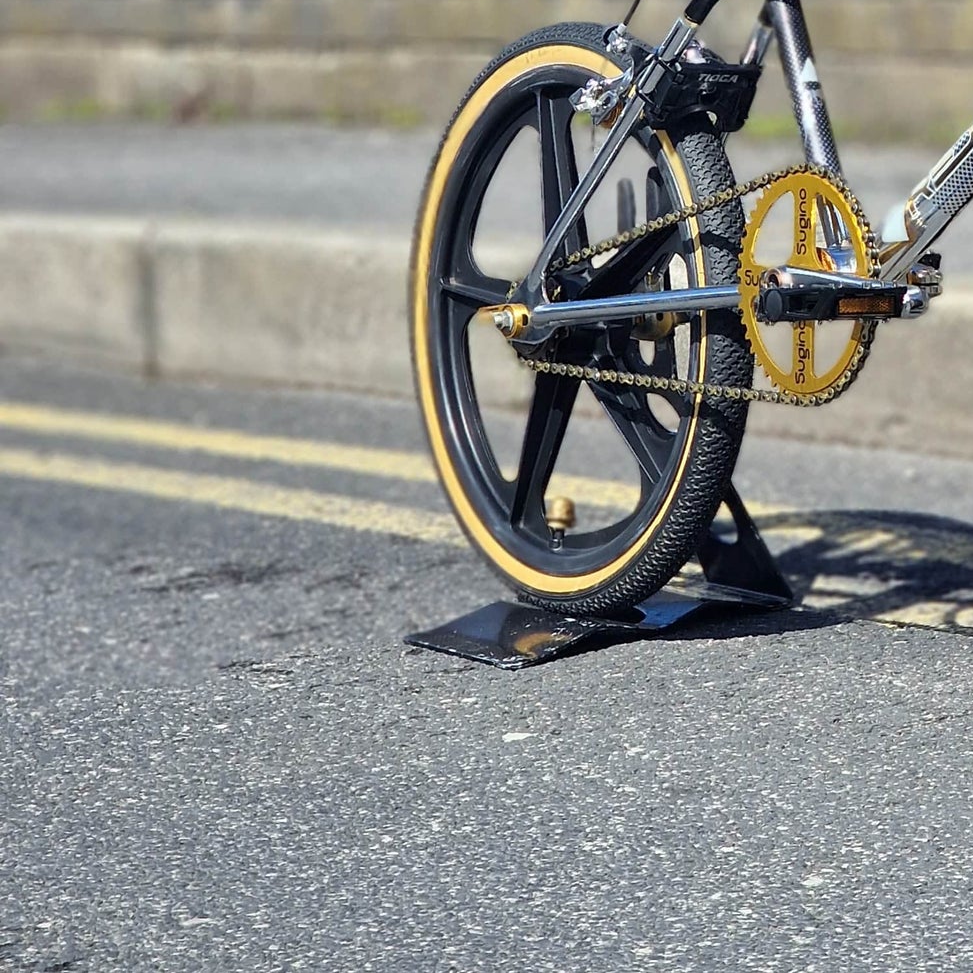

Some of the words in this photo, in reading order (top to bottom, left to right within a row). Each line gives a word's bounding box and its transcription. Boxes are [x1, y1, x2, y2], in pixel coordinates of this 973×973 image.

[698, 73, 739, 84] TIOGA
[797, 188, 811, 255] Sugino
[795, 321, 810, 384] Sugino
